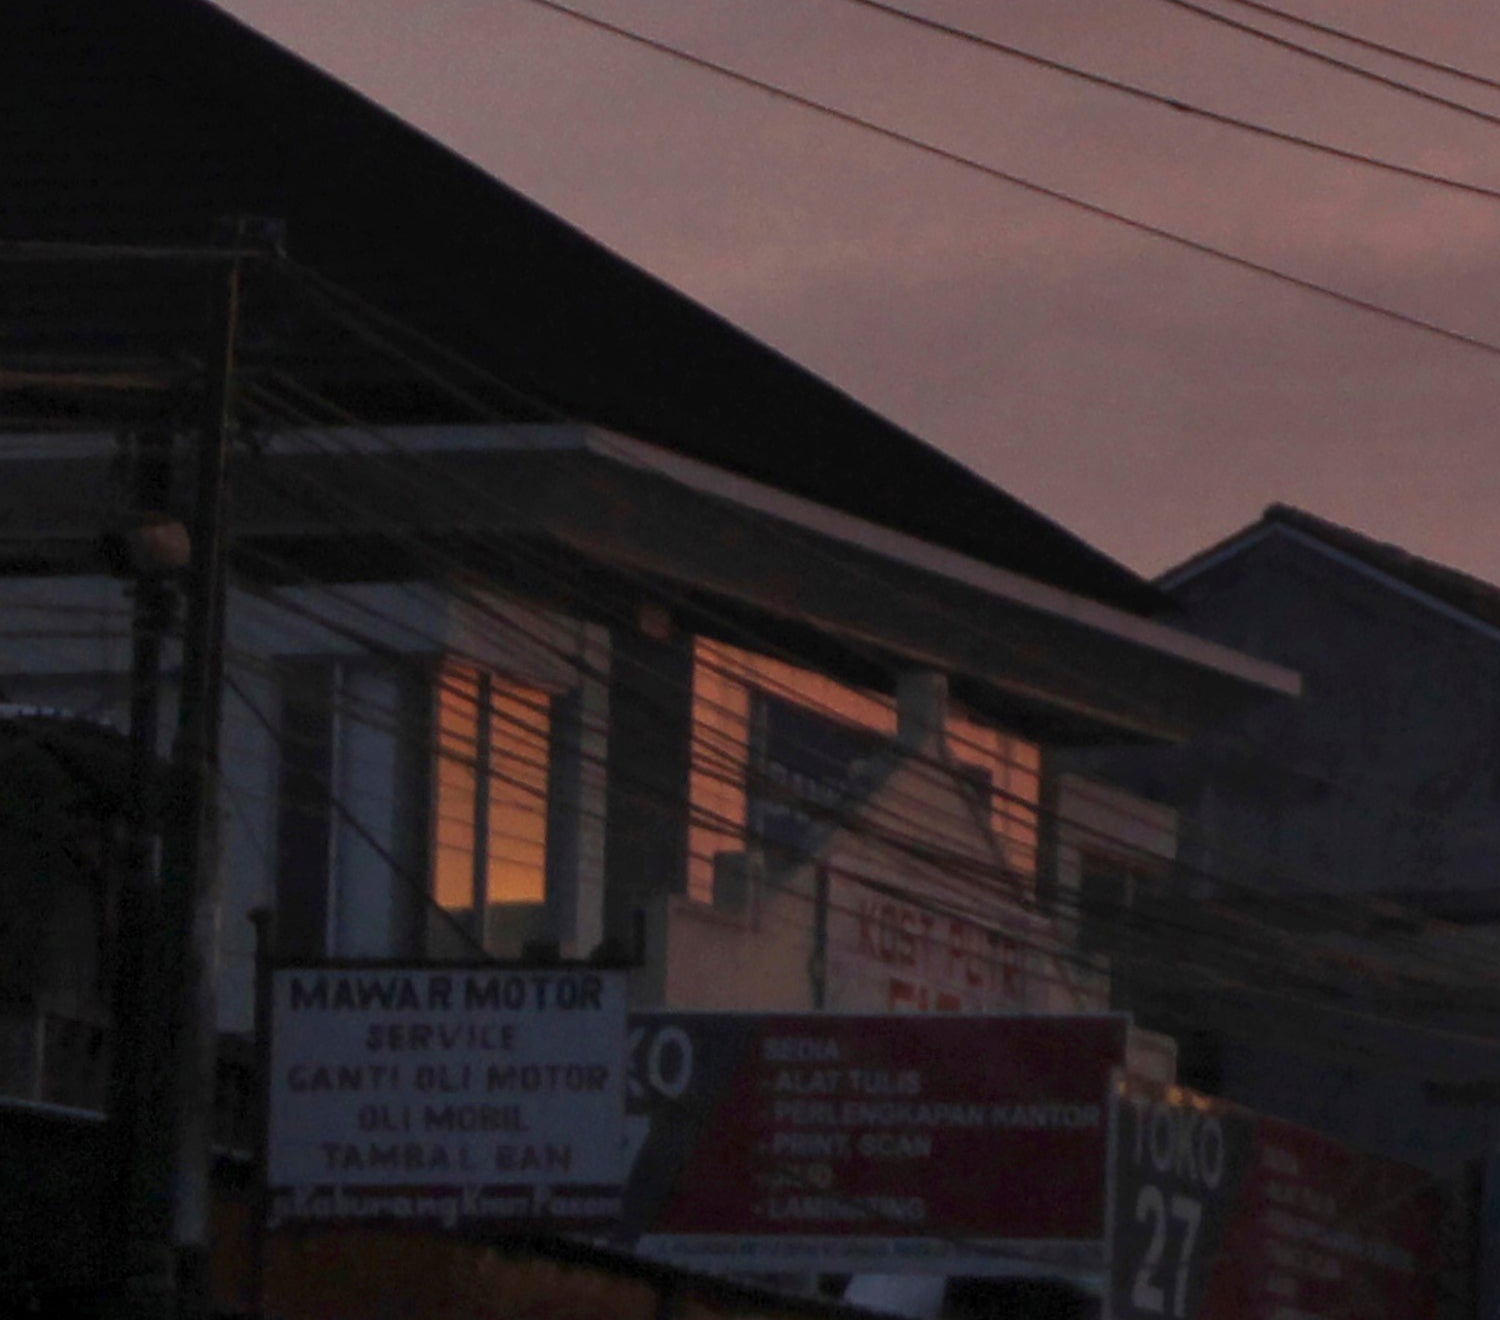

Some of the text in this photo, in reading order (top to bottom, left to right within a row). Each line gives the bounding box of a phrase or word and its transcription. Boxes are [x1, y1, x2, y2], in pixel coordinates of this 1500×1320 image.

[290, 976, 604, 1011] MAWAR MOTOR
[366, 1024, 517, 1051] SERVICE
[287, 1064, 610, 1092] GANTI OLI MOTOR
[848, 1069, 923, 1096] TULIS
[357, 1104, 527, 1132] OLI MOBIL
[991, 1103, 1101, 1128] KANTOR
[322, 1142, 573, 1172] TAMBAL BAN
[1129, 1098, 1224, 1189] TOKO
[1132, 1184, 1203, 1320] 27
